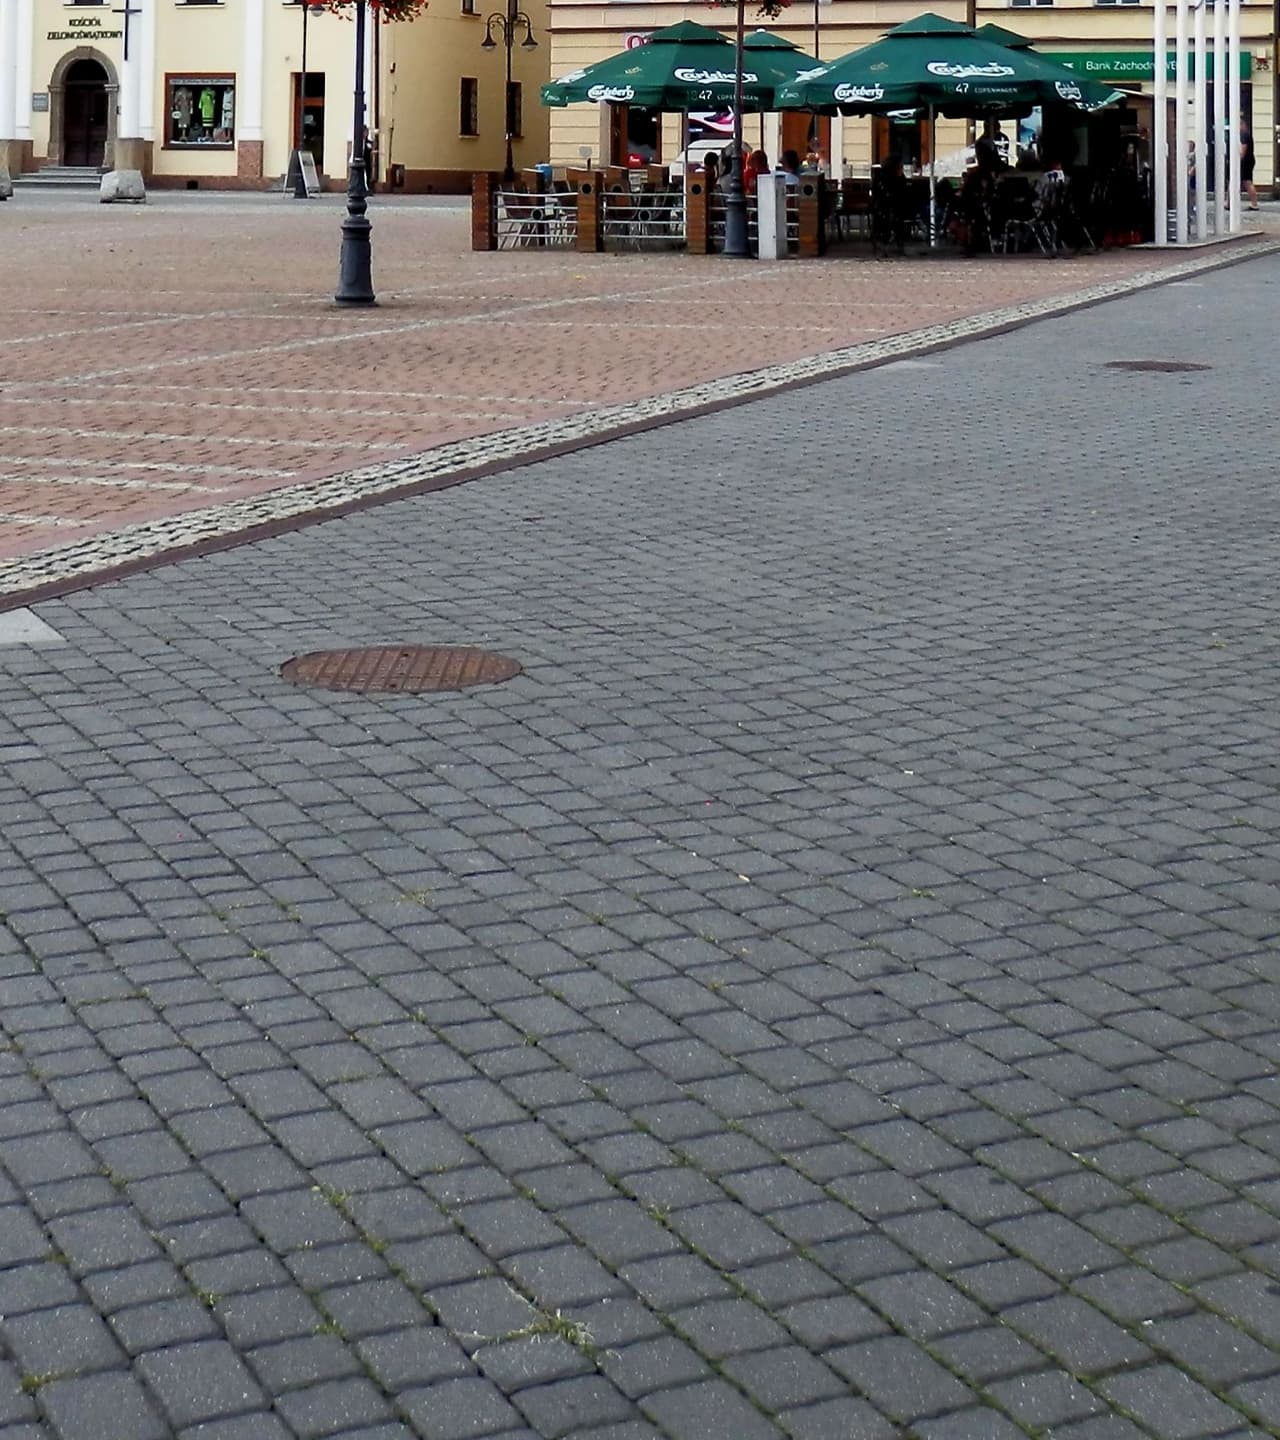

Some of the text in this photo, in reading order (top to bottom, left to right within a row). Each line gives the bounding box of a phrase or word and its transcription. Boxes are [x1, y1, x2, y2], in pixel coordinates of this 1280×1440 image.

[926, 62, 1015, 78] Carlsberg
[1086, 60, 1111, 71] Bank
[587, 85, 635, 101] Carlsberg
[834, 82, 885, 103] Carlsberg
